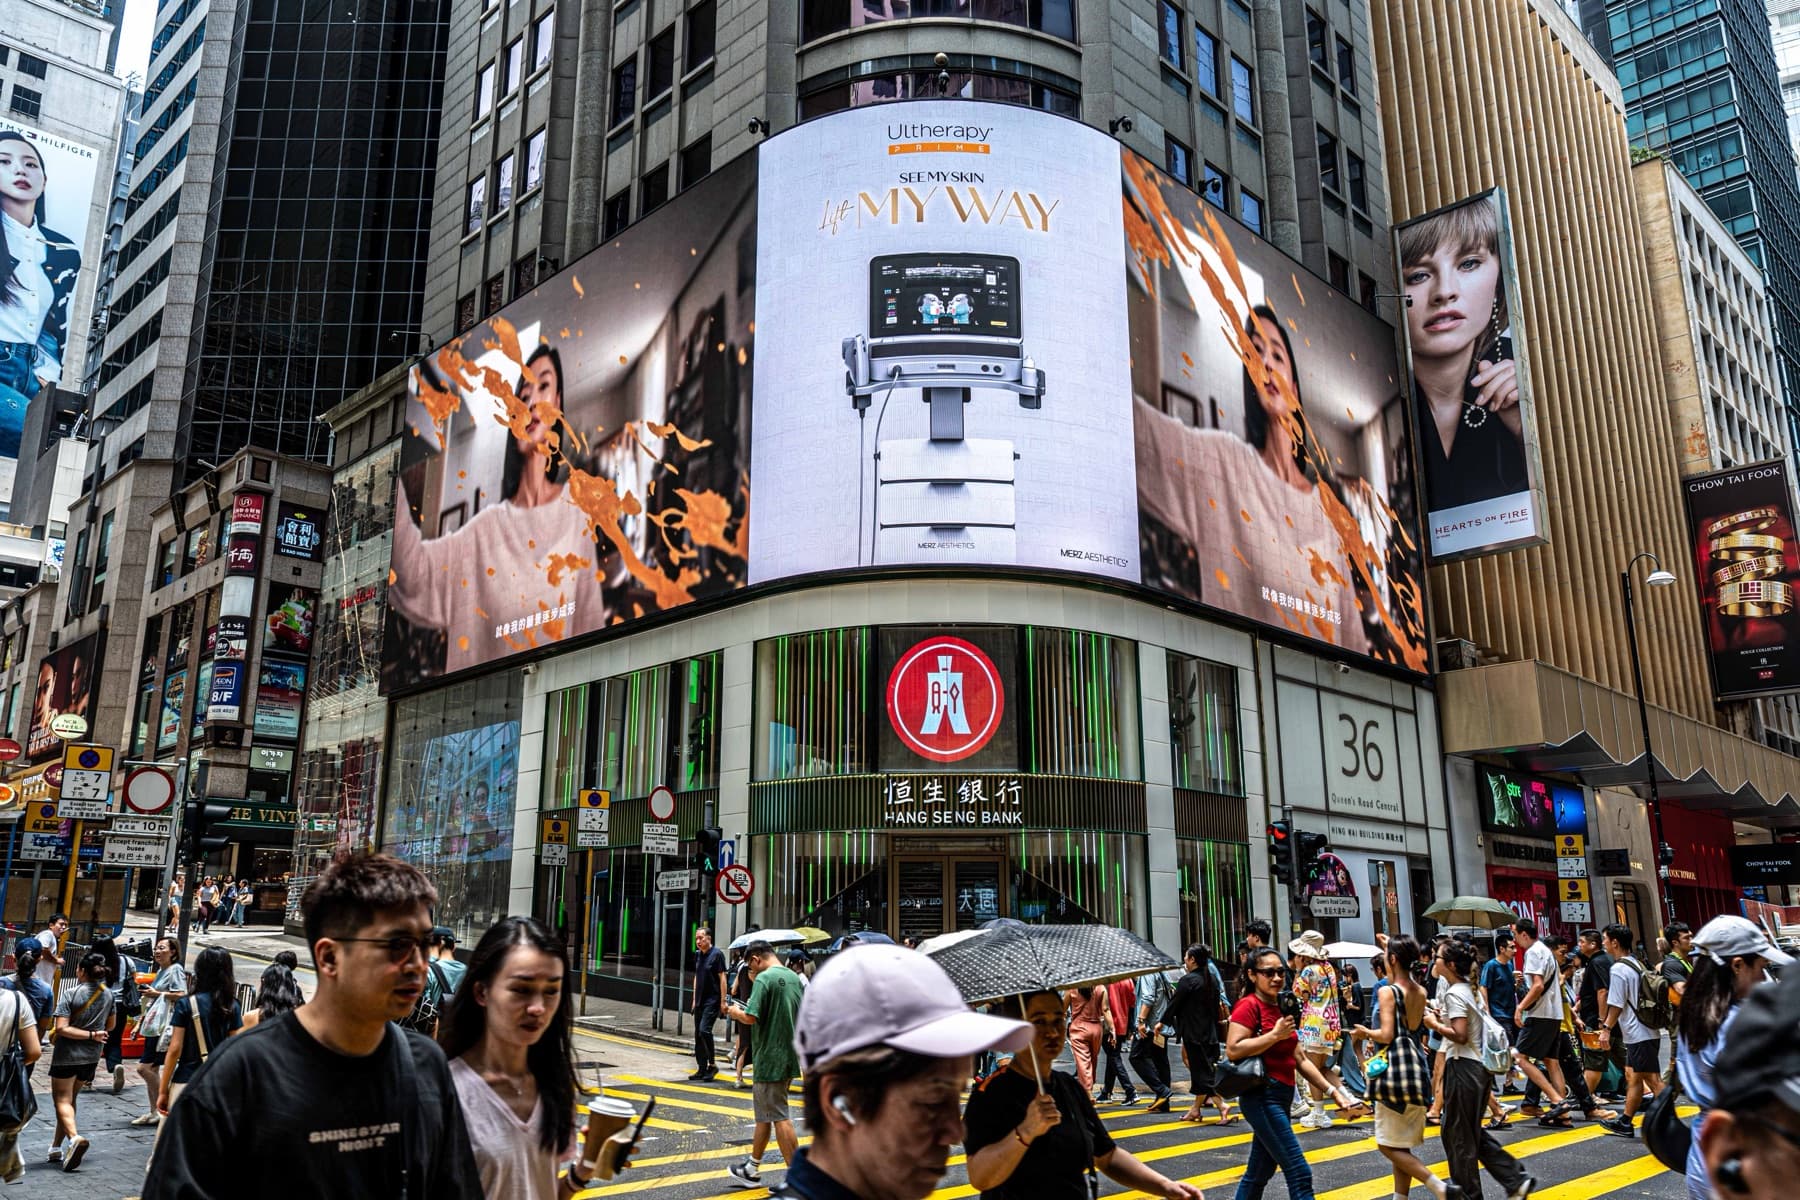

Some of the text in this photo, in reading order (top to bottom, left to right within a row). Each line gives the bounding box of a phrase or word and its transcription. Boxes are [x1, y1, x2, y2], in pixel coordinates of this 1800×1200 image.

[888, 123, 988, 141] Ultherapy
[41, 136, 92, 158] HILFIGER
[894, 144, 984, 153] PRIME
[900, 171, 984, 183] SEE MY SKIN
[858, 186, 938, 229] MY
[946, 186, 1060, 232] WAY
[1690, 466, 1780, 492] CHOW TAI FOOK
[1435, 519, 1482, 534] HEARTS
[1500, 509, 1528, 520] FIRE
[1061, 548, 1128, 568] MERZ AESTHETICS
[212, 692, 232, 702] 8/F
[1339, 713, 1384, 782] 36
[94, 773, 102, 783] 7
[92, 788, 100, 798] 7
[884, 779, 1023, 805] 恒生銀行
[1332, 793, 1399, 812] Queen's Road Central
[231, 808, 251, 820] HE
[885, 812, 1023, 824] HANG SENG BANK
[1360, 830, 1384, 840] BUILDING
[1493, 841, 1533, 860] UNDER
[339, 1137, 385, 1152] NIGHT
